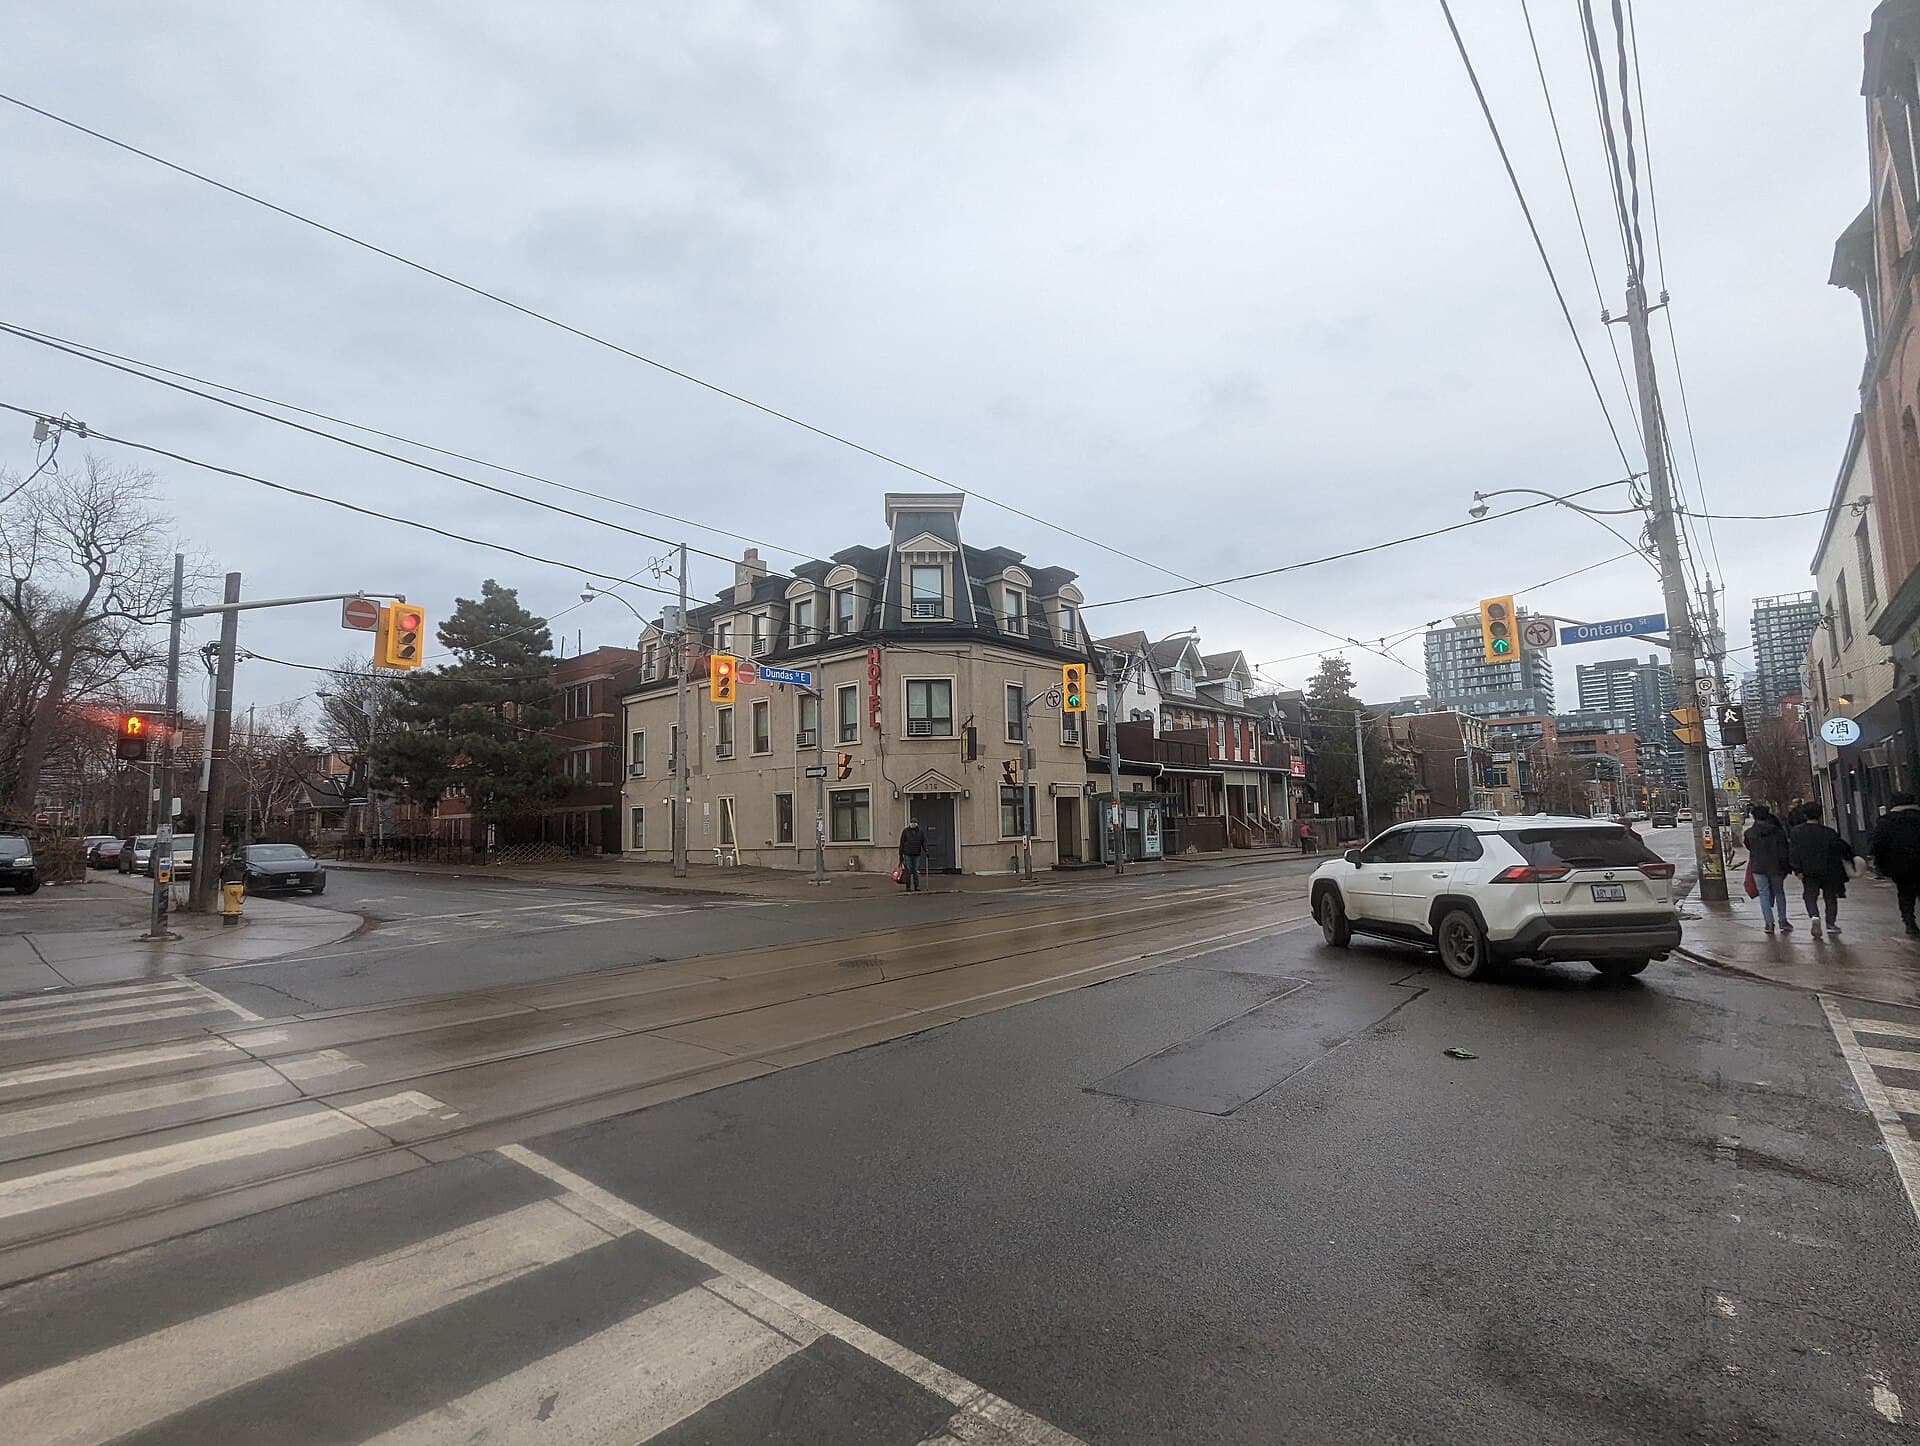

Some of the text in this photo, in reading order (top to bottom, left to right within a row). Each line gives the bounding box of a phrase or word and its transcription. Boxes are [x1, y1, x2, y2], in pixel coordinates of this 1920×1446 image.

[1577, 622, 1633, 638] Ontario
[765, 668, 794, 681] Dundas
[800, 672, 806, 682] E
[867, 647, 880, 729] HOTEL
[1830, 720, 1849, 735] 酒
